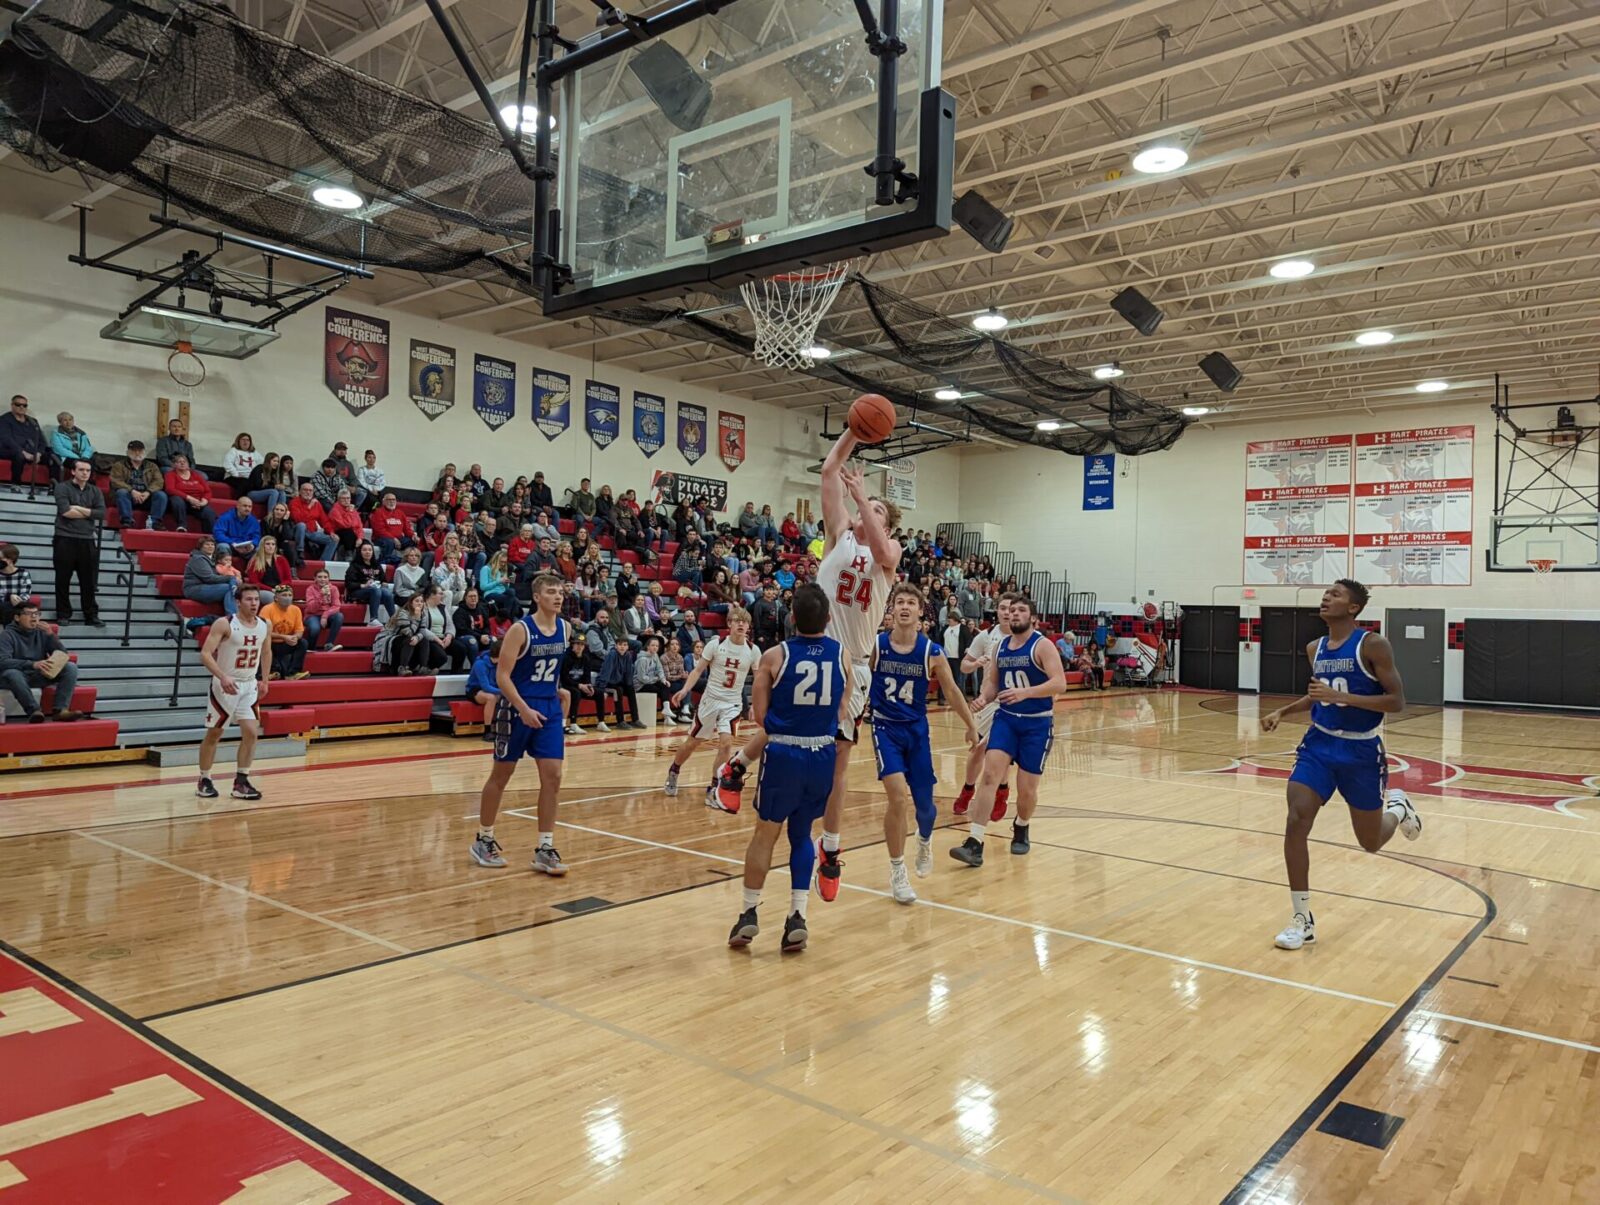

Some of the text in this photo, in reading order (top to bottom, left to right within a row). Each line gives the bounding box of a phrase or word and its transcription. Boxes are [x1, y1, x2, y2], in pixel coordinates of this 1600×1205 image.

[328, 322, 388, 344] CONFERENCE
[352, 319, 383, 333] MICHIGAN
[412, 351, 455, 366] CONFERENCE
[476, 364, 514, 379] CONFERENCE
[345, 384, 369, 393] HART
[534, 378, 569, 392] CONFERENCE
[338, 390, 376, 408] PIRATES
[586, 390, 618, 402] CONFERENCE
[418, 401, 447, 415] SPARTANS
[635, 401, 664, 412] CONFERENCE
[480, 412, 507, 426] WILDCATS
[679, 410, 706, 422] CONFERENCE
[720, 419, 744, 430] CONFERENCE
[593, 433, 612, 445] EAGLES
[1416, 428, 1448, 436] PIRATES
[678, 480, 725, 497] PIRATE
[836, 570, 873, 612] 24
[244, 635, 258, 646] H
[235, 650, 259, 668] 22
[725, 658, 741, 669] H
[531, 658, 558, 682] 32
[880, 660, 922, 677] MONTAGUE
[723, 670, 736, 688] 3
[793, 661, 833, 705] 21
[884, 677, 914, 704] 24
